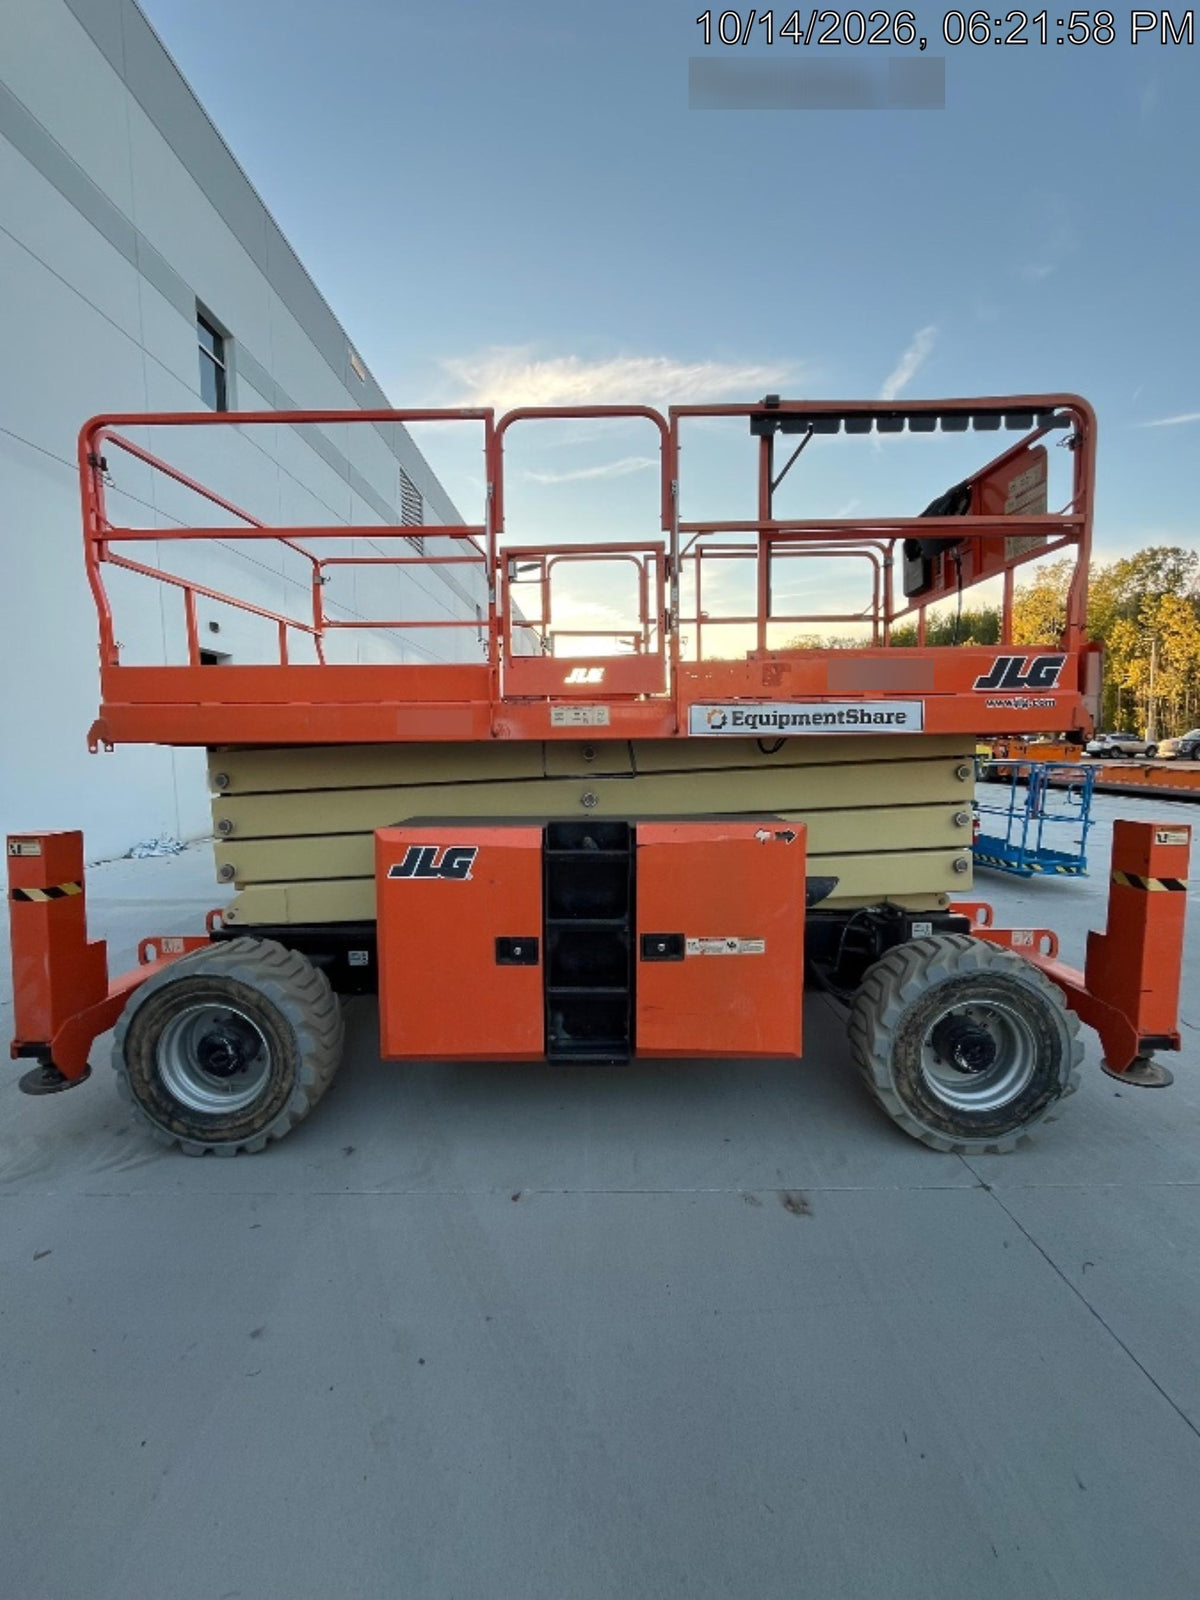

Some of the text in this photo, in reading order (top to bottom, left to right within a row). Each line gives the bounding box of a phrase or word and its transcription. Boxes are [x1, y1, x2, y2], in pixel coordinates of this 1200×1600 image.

[972, 655, 1068, 690] JLG
[731, 708, 907, 729] EquipmentShare
[387, 845, 479, 880] JLG
